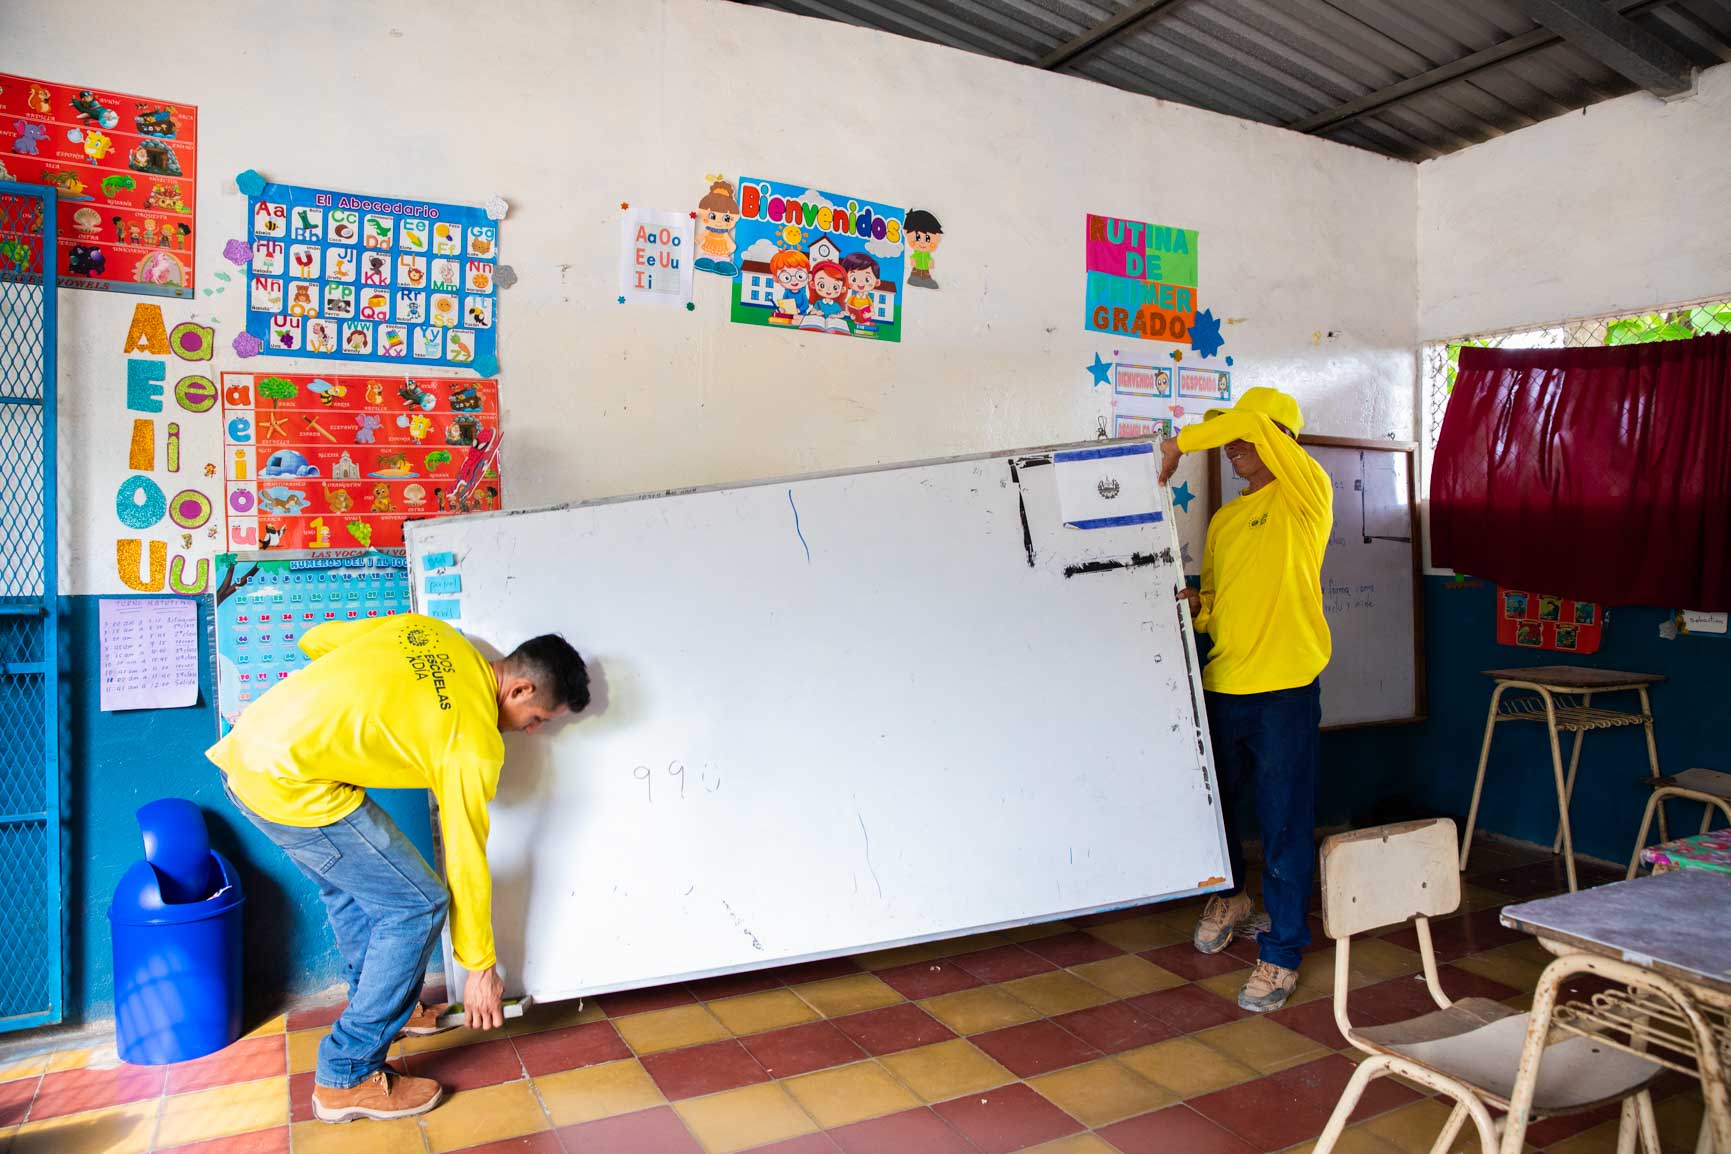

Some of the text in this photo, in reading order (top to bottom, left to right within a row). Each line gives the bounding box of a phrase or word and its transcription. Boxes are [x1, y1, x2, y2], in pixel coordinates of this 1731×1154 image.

[256, 200, 286, 218] Aa
[316, 194, 439, 218] El Abecedario
[742, 184, 900, 243] Bienvenidos
[331, 208, 357, 224] Cc
[403, 218, 426, 231] Ee
[294, 228, 321, 241] Bb
[471, 226, 495, 241] Gg
[1090, 215, 1188, 254] RUTINA
[256, 240, 283, 254] Hh
[366, 235, 391, 251] Dd
[437, 242, 455, 256] Ff
[338, 249, 354, 263] Jj
[469, 258, 492, 274] Nn
[1126, 251, 1162, 281] DE
[365, 272, 389, 287] Kk
[433, 280, 458, 291] Mm
[328, 282, 353, 299] Pp
[401, 289, 421, 301] Rr
[1091, 271, 1192, 313] PRIMER
[290, 303, 318, 319] Oo
[361, 306, 387, 324] Qq
[273, 313, 300, 329] Uu
[346, 320, 371, 332] Ww
[1093, 305, 1187, 339] GRADO
[420, 325, 440, 343] Yy
[310, 339, 335, 354] Vv
[382, 345, 403, 358] Xx
[226, 385, 251, 406] a
[228, 418, 251, 443] e
[235, 449, 247, 479] i
[229, 491, 255, 513] o
[232, 526, 257, 545] u
[345, 559, 365, 567] DEL
[436, 654, 455, 673] DOS
[424, 654, 451, 710] ESCUELAS
